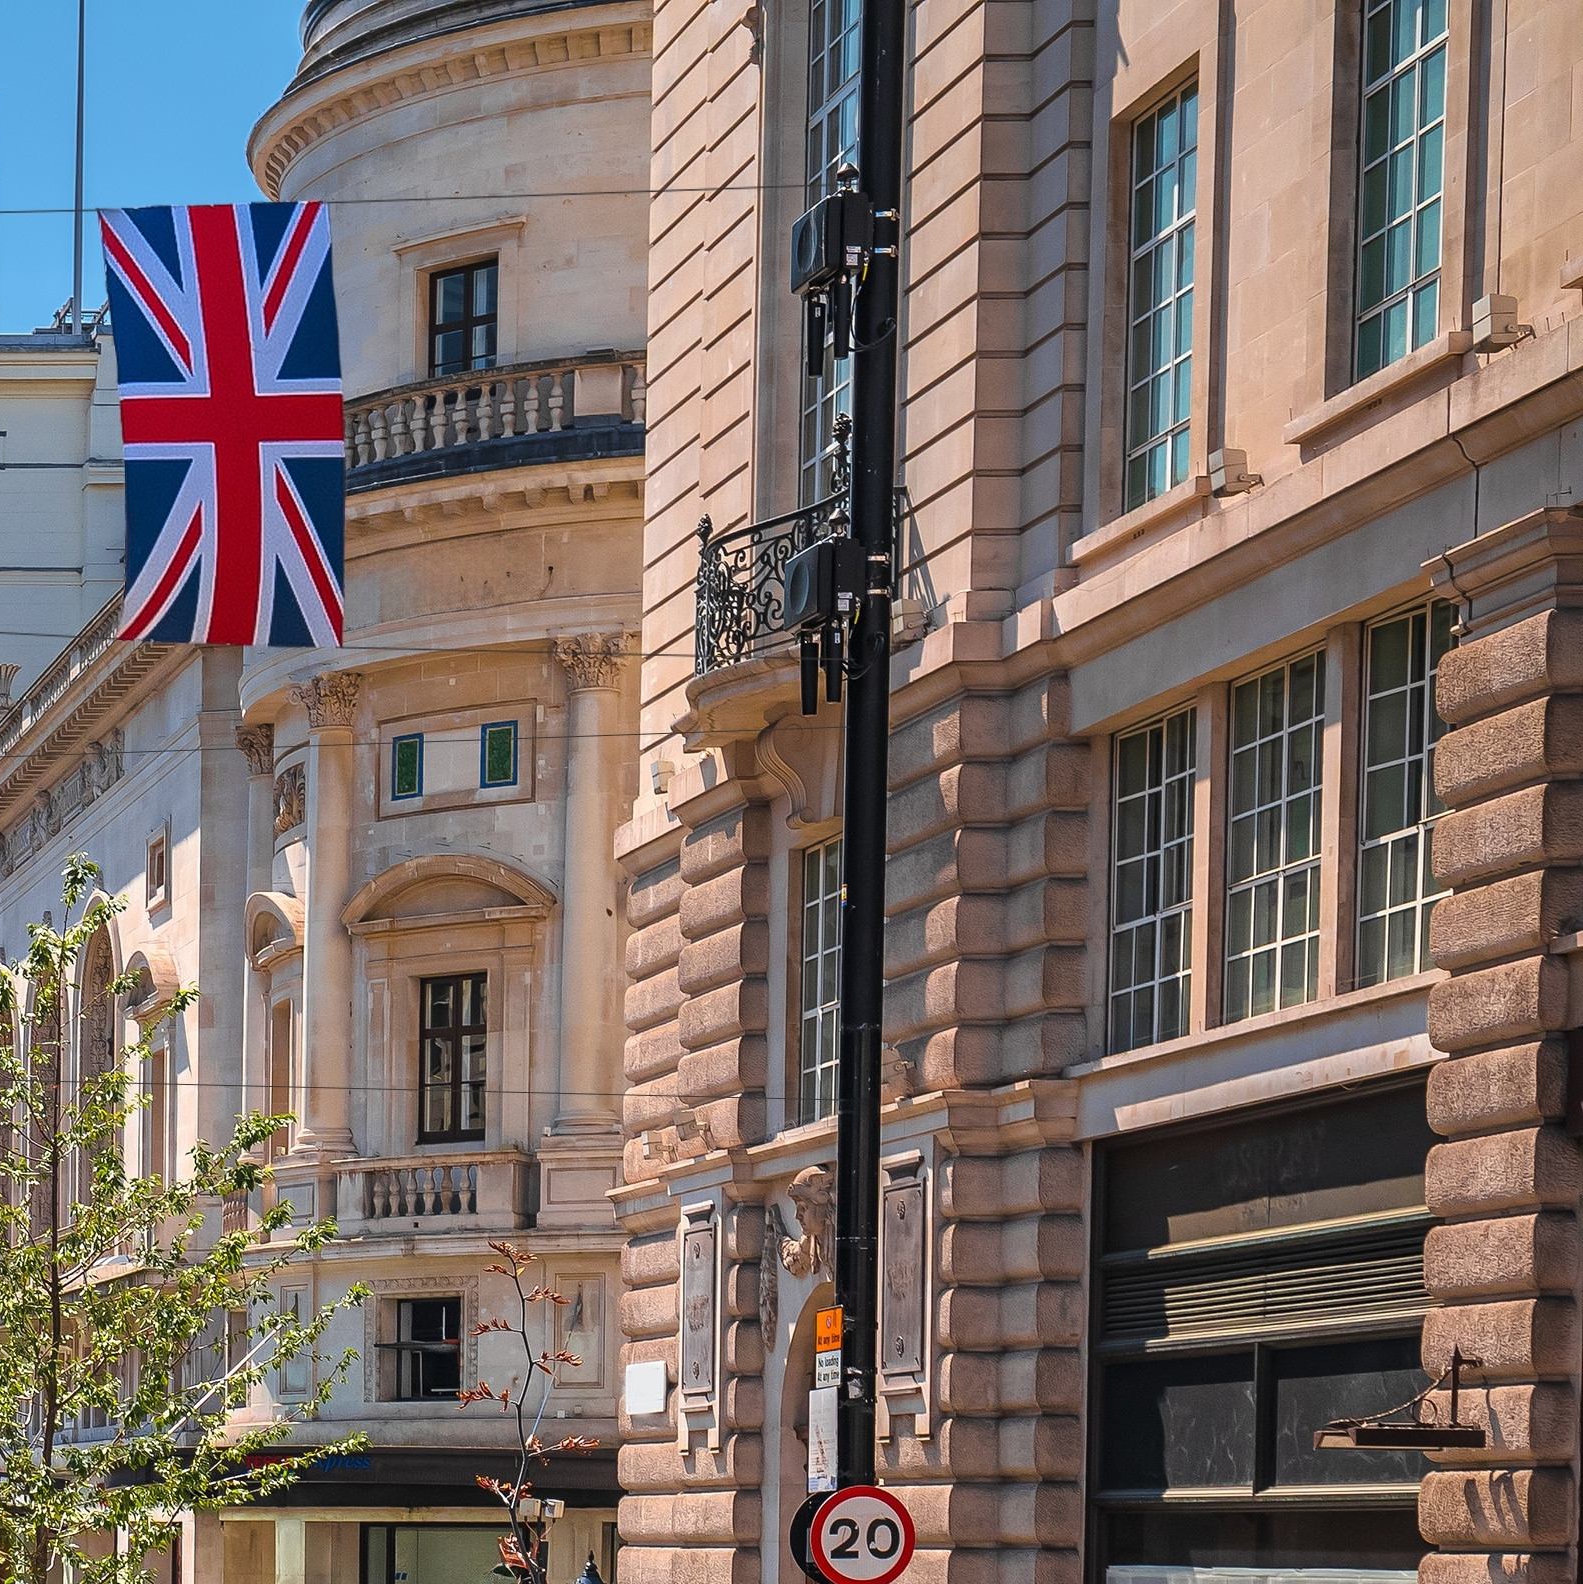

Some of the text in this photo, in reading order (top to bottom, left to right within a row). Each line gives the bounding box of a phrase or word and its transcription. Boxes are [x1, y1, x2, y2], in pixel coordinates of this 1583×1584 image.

[825, 1355, 839, 1367] loading
[831, 1370, 840, 1380] time
[244, 1455, 371, 1473] TESC xpress
[828, 1517, 901, 1560] 20
